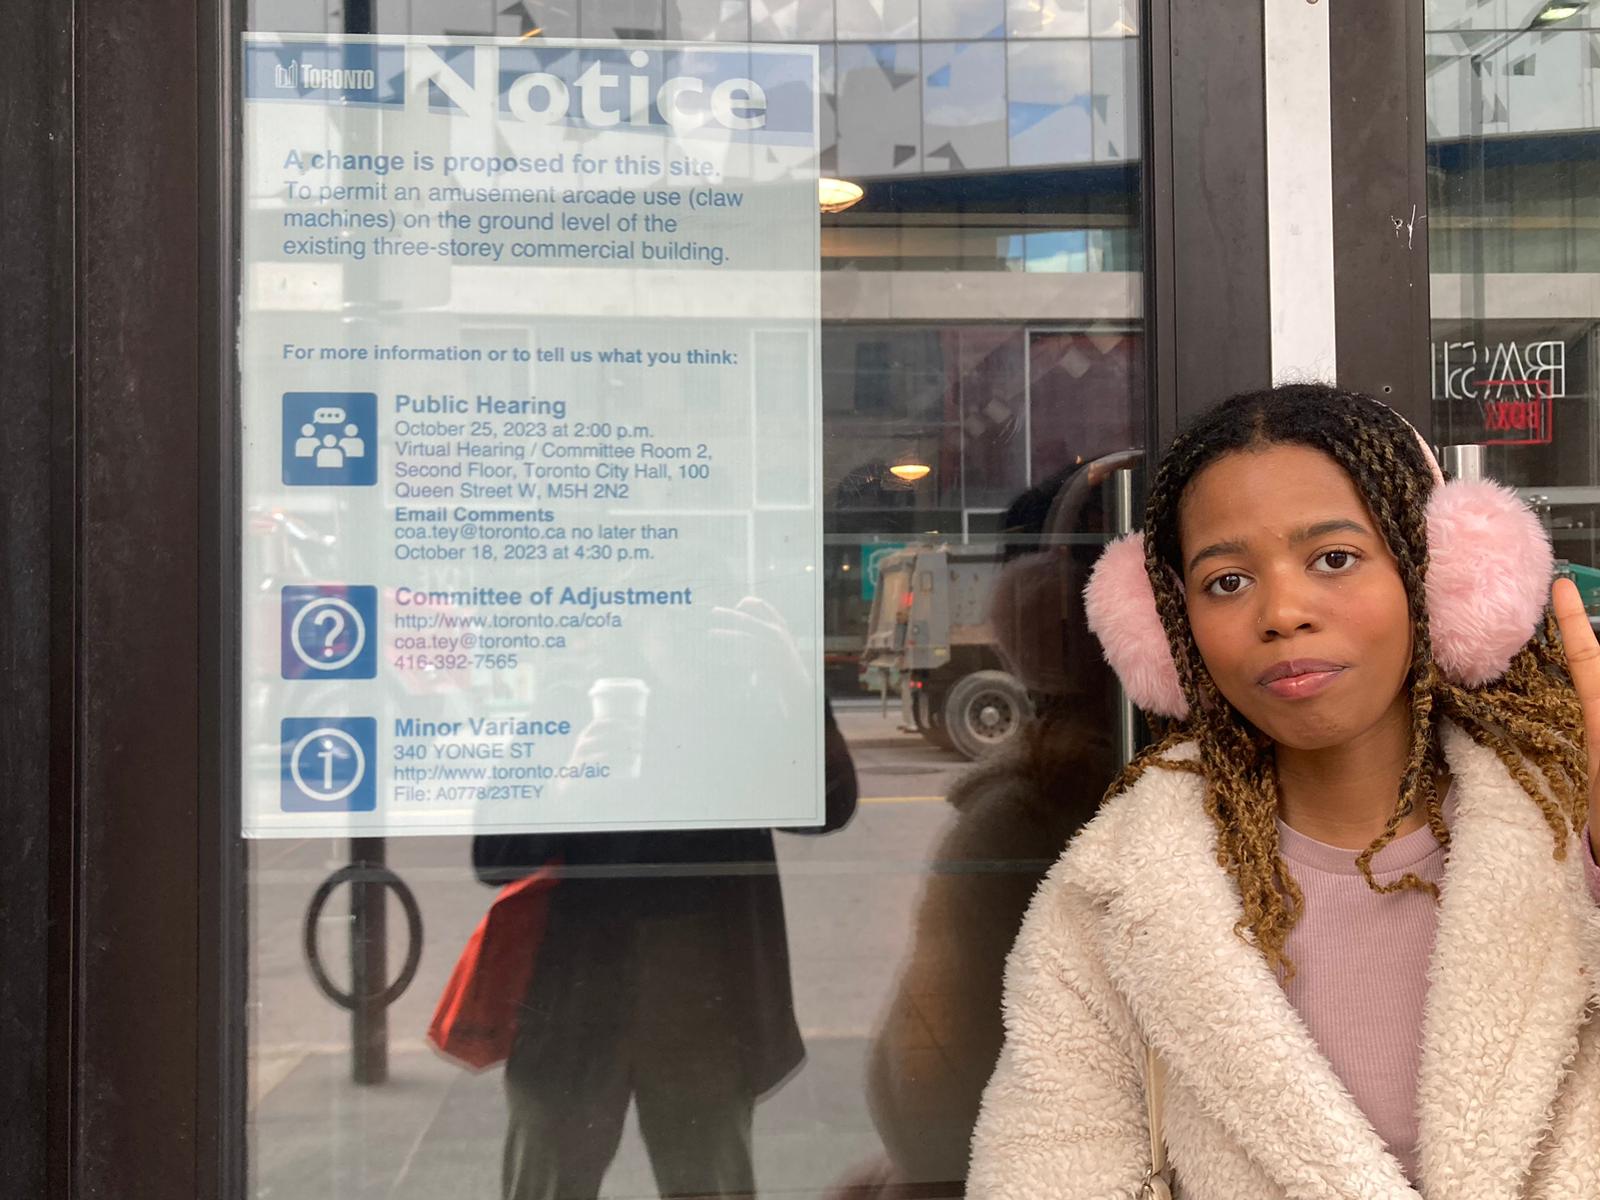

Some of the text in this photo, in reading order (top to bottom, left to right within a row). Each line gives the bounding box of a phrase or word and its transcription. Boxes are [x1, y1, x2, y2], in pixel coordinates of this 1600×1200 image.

[301, 64, 375, 89] TORONTO
[404, 44, 767, 130] Notice
[283, 150, 720, 177] A change is proposed for this site.
[284, 181, 743, 210] To permit an amusement arcade use (claw
[284, 209, 677, 234] machines) on the ground level of the
[283, 236, 729, 265] existing three-storey commercial building.
[283, 344, 738, 367] For more information or to tell us what you think:
[395, 395, 566, 418] Public Hearing
[395, 421, 654, 440] October 25, 2023 at 2:00 p.m.
[395, 442, 712, 460] Virtual Hearing / Committee Room 2,
[395, 462, 709, 481] Second Floor, Toronto City Hall, 100
[395, 482, 629, 499] Queen Street W, M5H 2N2
[395, 507, 554, 522] Email Comments
[394, 523, 678, 541] coa.tey@toronto.ca no later than
[395, 544, 654, 562] October 18, 2023 at 4:30 p.m.
[395, 586, 692, 609] Committee of Adjustment
[394, 612, 622, 631] http://www.toronto.ca/cofa
[394, 636, 566, 652] coa.tey@toronto.ca
[394, 654, 518, 670] 416-392-7565
[395, 717, 571, 737] Minor Variance
[394, 743, 535, 760] 340 YONGE ST
[394, 764, 610, 783] http://www.toronto.ca/aic
[394, 785, 544, 801] File: A0778/23TEY
